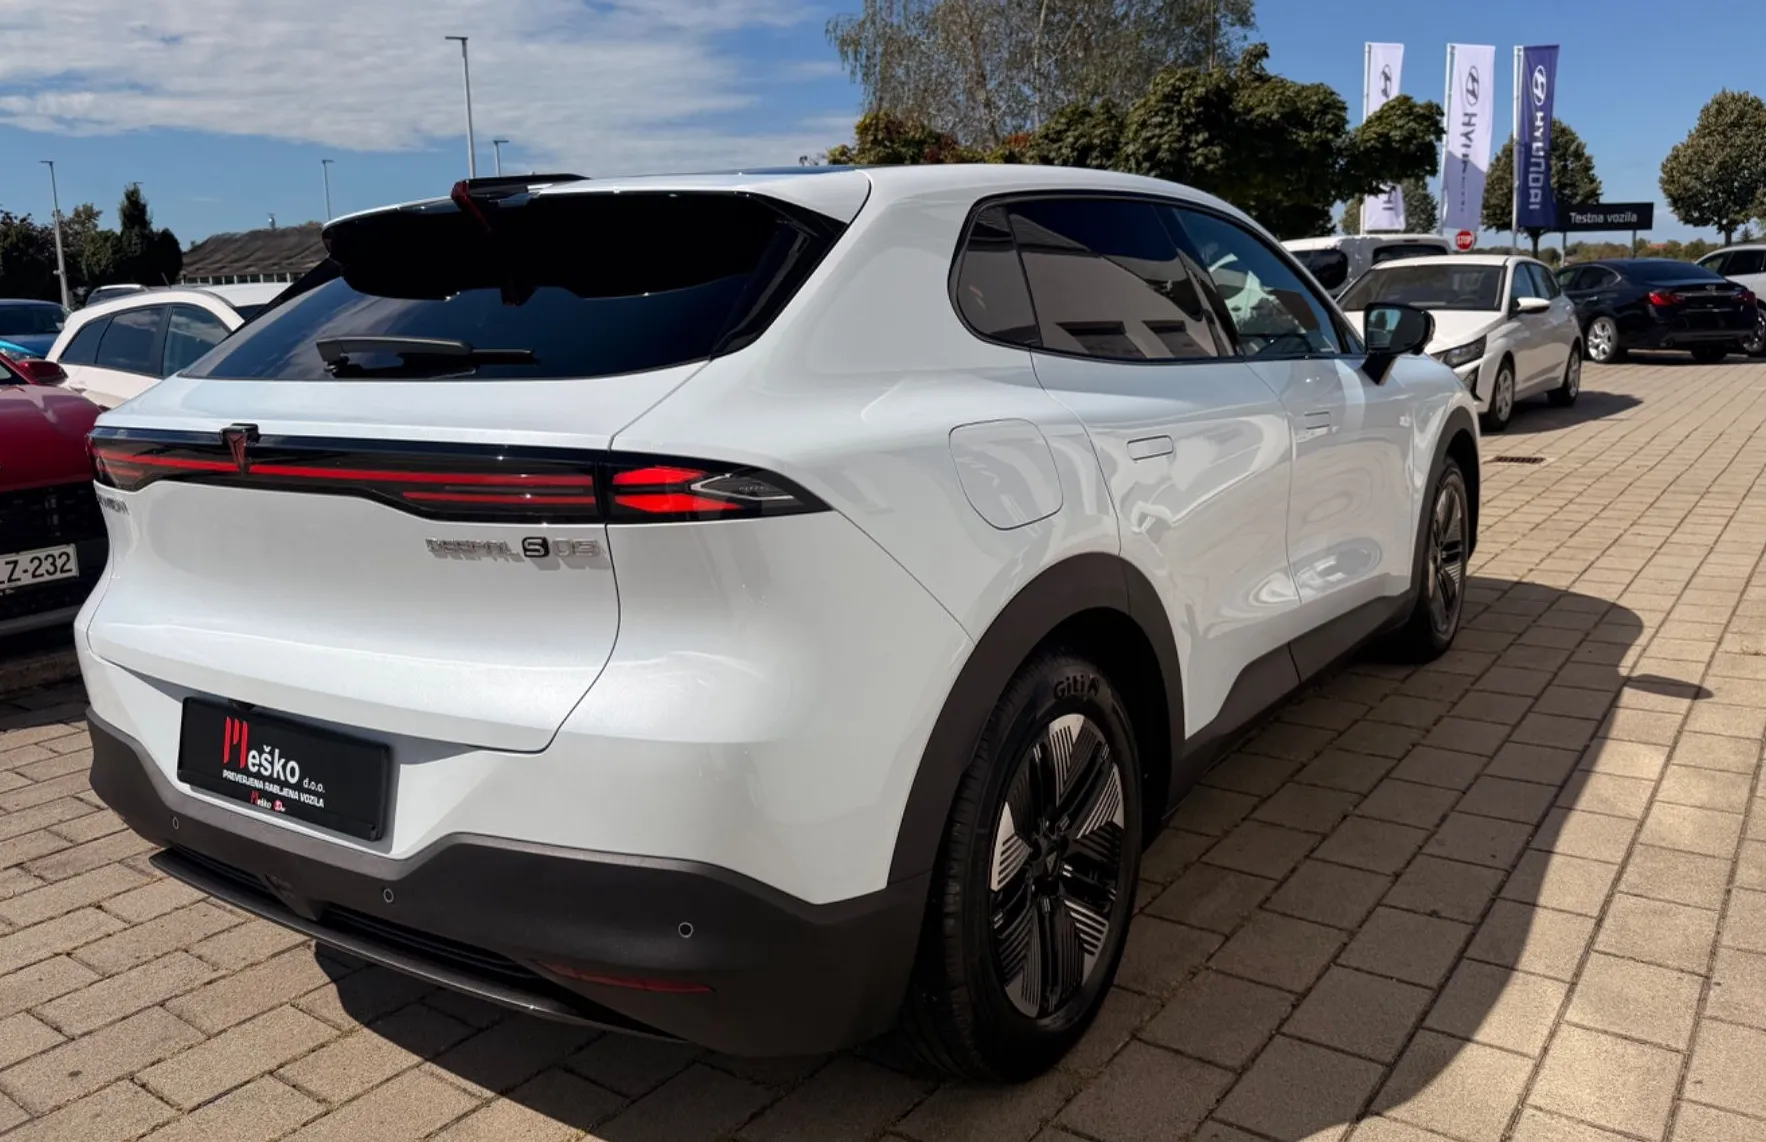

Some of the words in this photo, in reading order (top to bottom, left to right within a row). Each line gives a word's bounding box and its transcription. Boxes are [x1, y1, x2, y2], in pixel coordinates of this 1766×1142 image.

[1528, 111, 1546, 210] HYUNDAI
[1570, 212, 1603, 224] Testna
[1607, 211, 1638, 223] vozila
[1455, 234, 1474, 245] STOP
[222, 769, 264, 791] PREVERJENA
[264, 781, 299, 801] RABLJENA
[300, 792, 325, 809] VOZILA
[302, 777, 326, 793] d.o.o.
